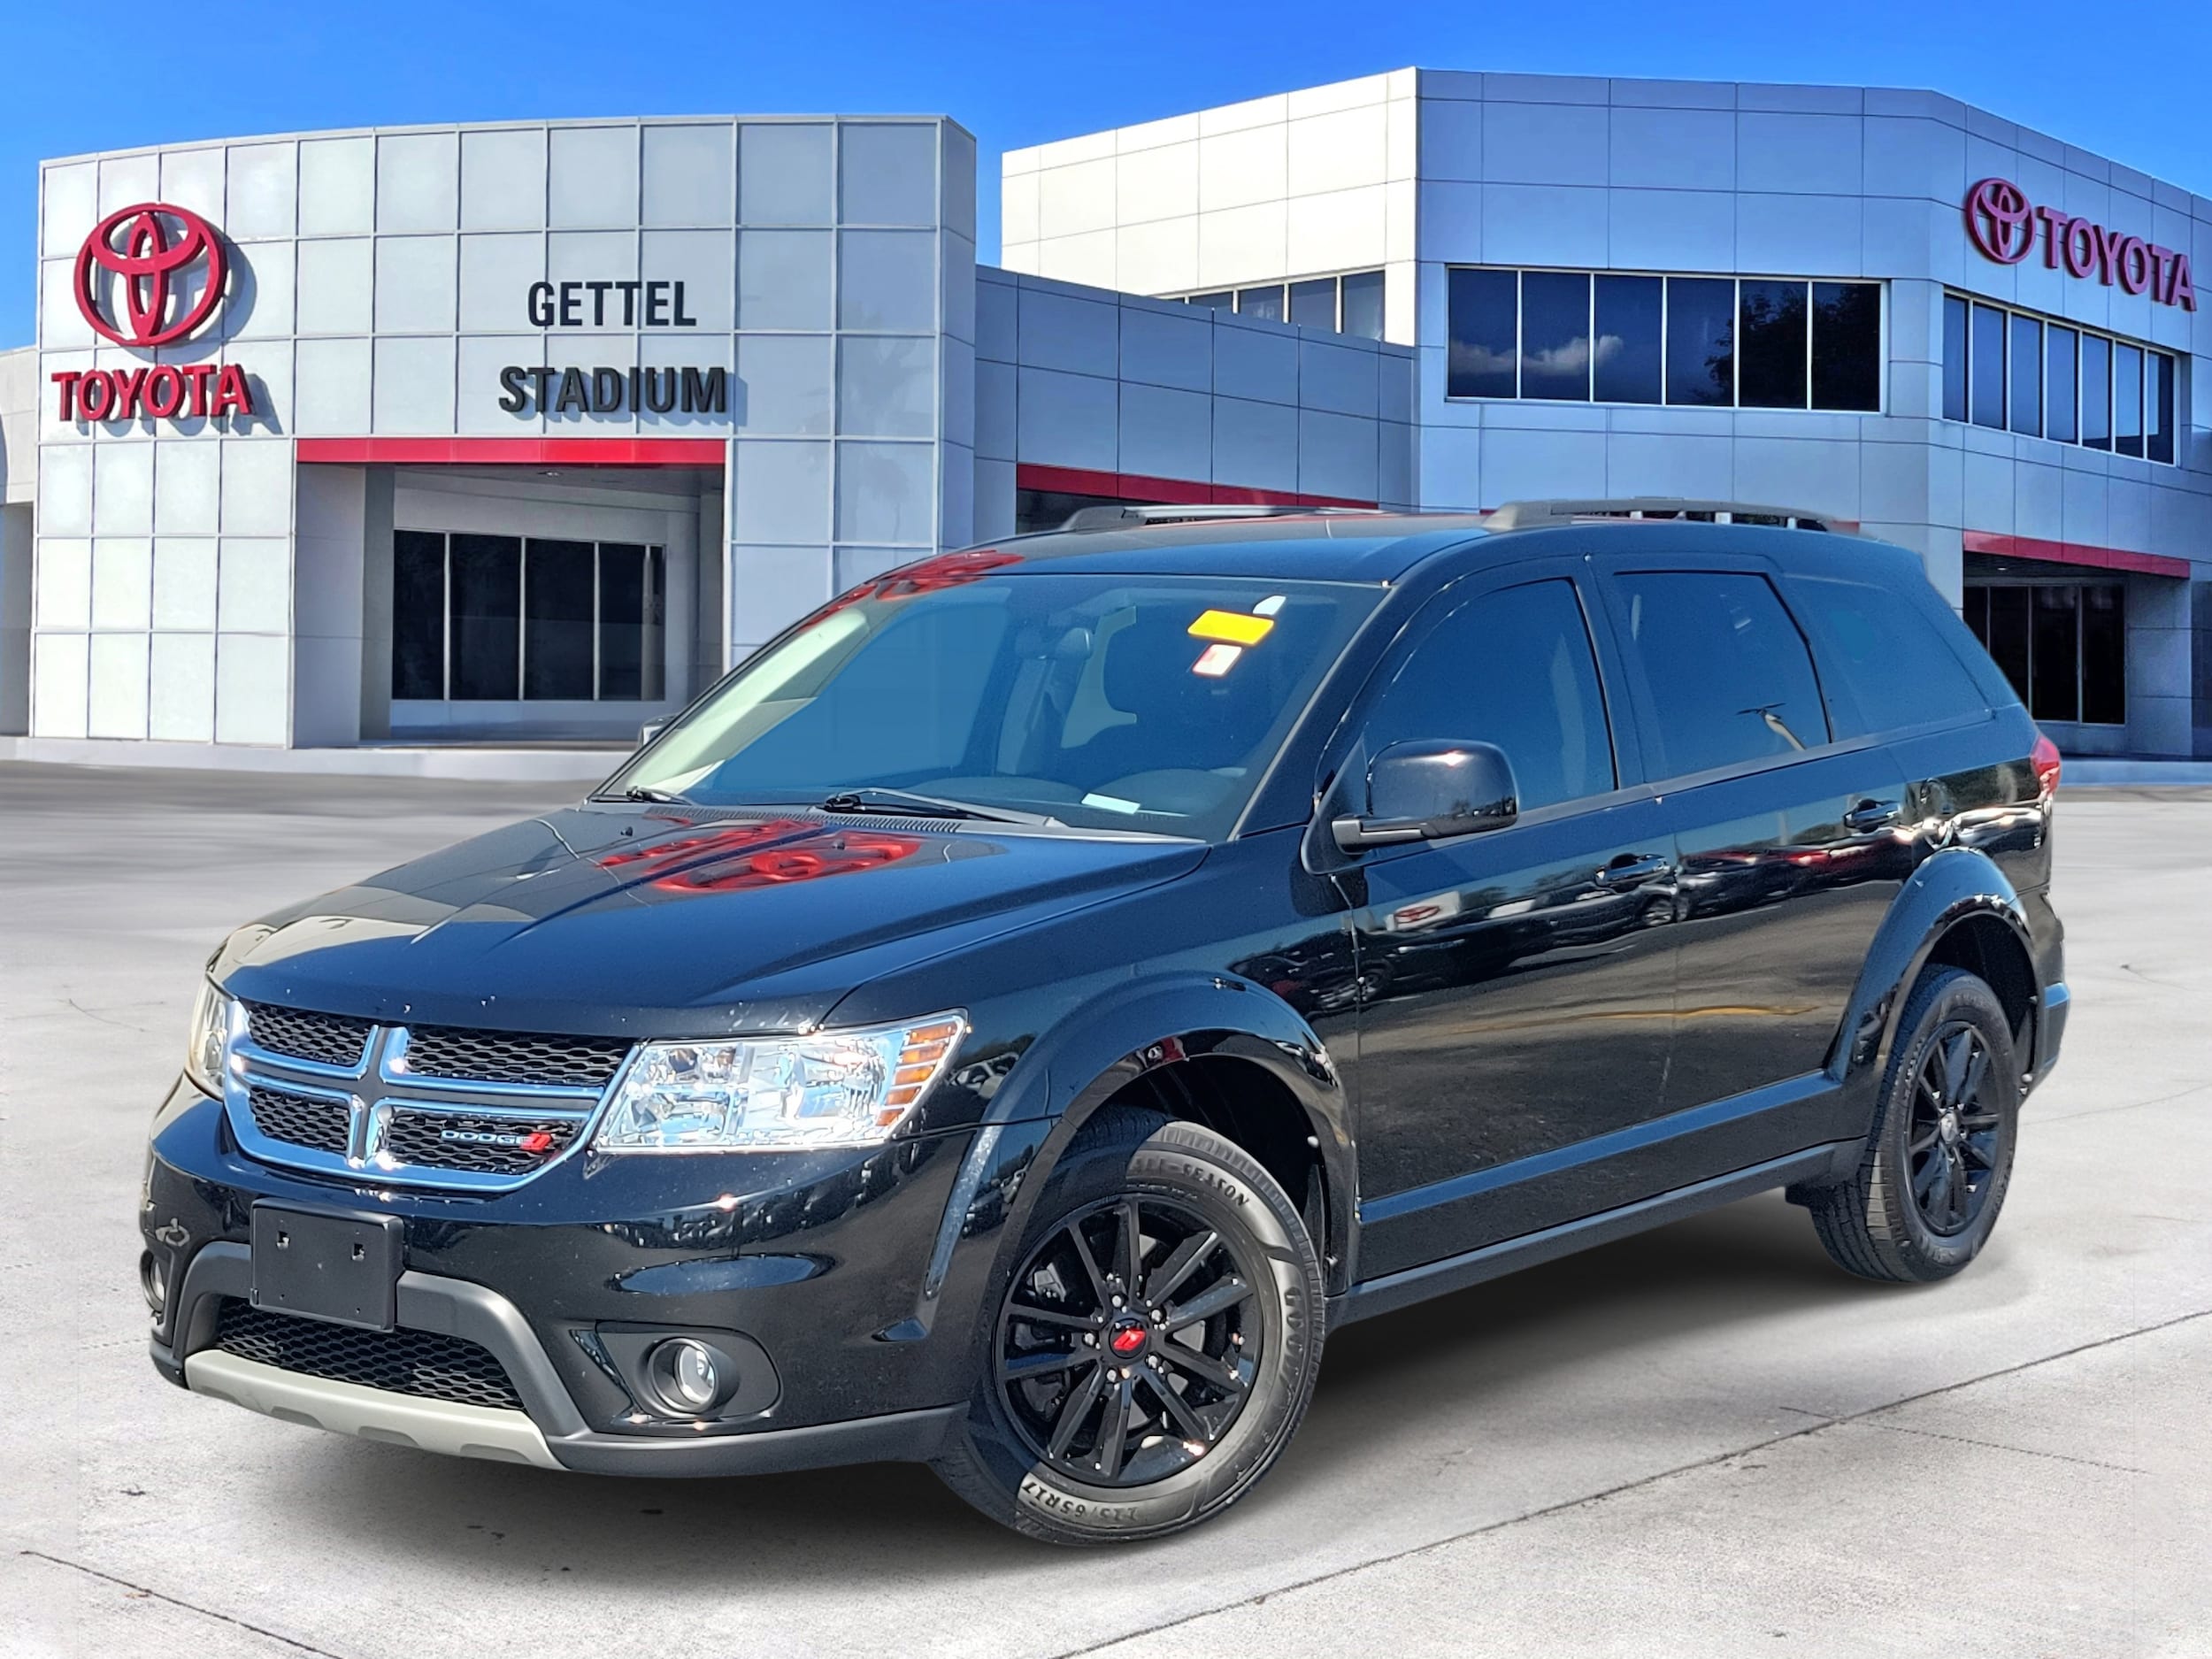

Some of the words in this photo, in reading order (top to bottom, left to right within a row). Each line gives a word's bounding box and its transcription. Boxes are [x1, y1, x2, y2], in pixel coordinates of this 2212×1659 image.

[2037, 205, 2197, 311] TOYOTA
[528, 281, 696, 326] GETTEL
[51, 364, 254, 421] TOYOTA
[498, 366, 727, 412] STADIUM
[442, 1130, 531, 1147] DODGE
